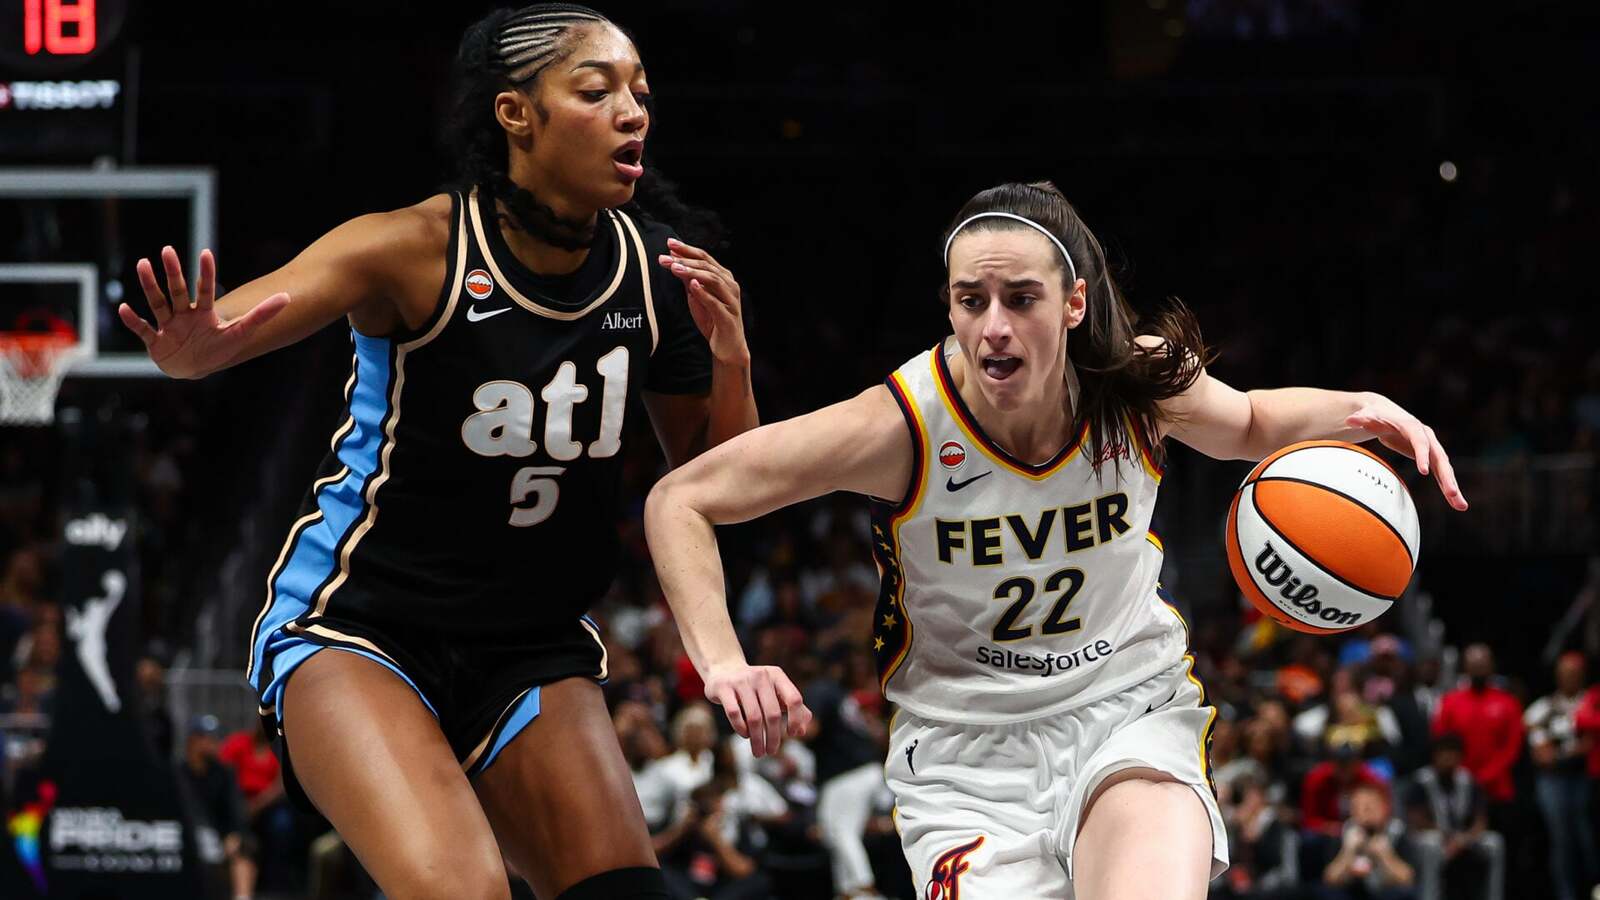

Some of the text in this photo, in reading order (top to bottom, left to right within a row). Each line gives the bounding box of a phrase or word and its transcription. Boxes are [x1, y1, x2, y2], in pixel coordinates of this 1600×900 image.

[24, 0, 96, 55] 18
[601, 312, 643, 330] Albert
[461, 346, 629, 461] atl
[508, 466, 567, 527] 5
[935, 492, 1133, 566] FEVER
[991, 566, 1088, 644] 22
[1254, 540, 1362, 625] Wilson
[976, 639, 1113, 677] salesforce
